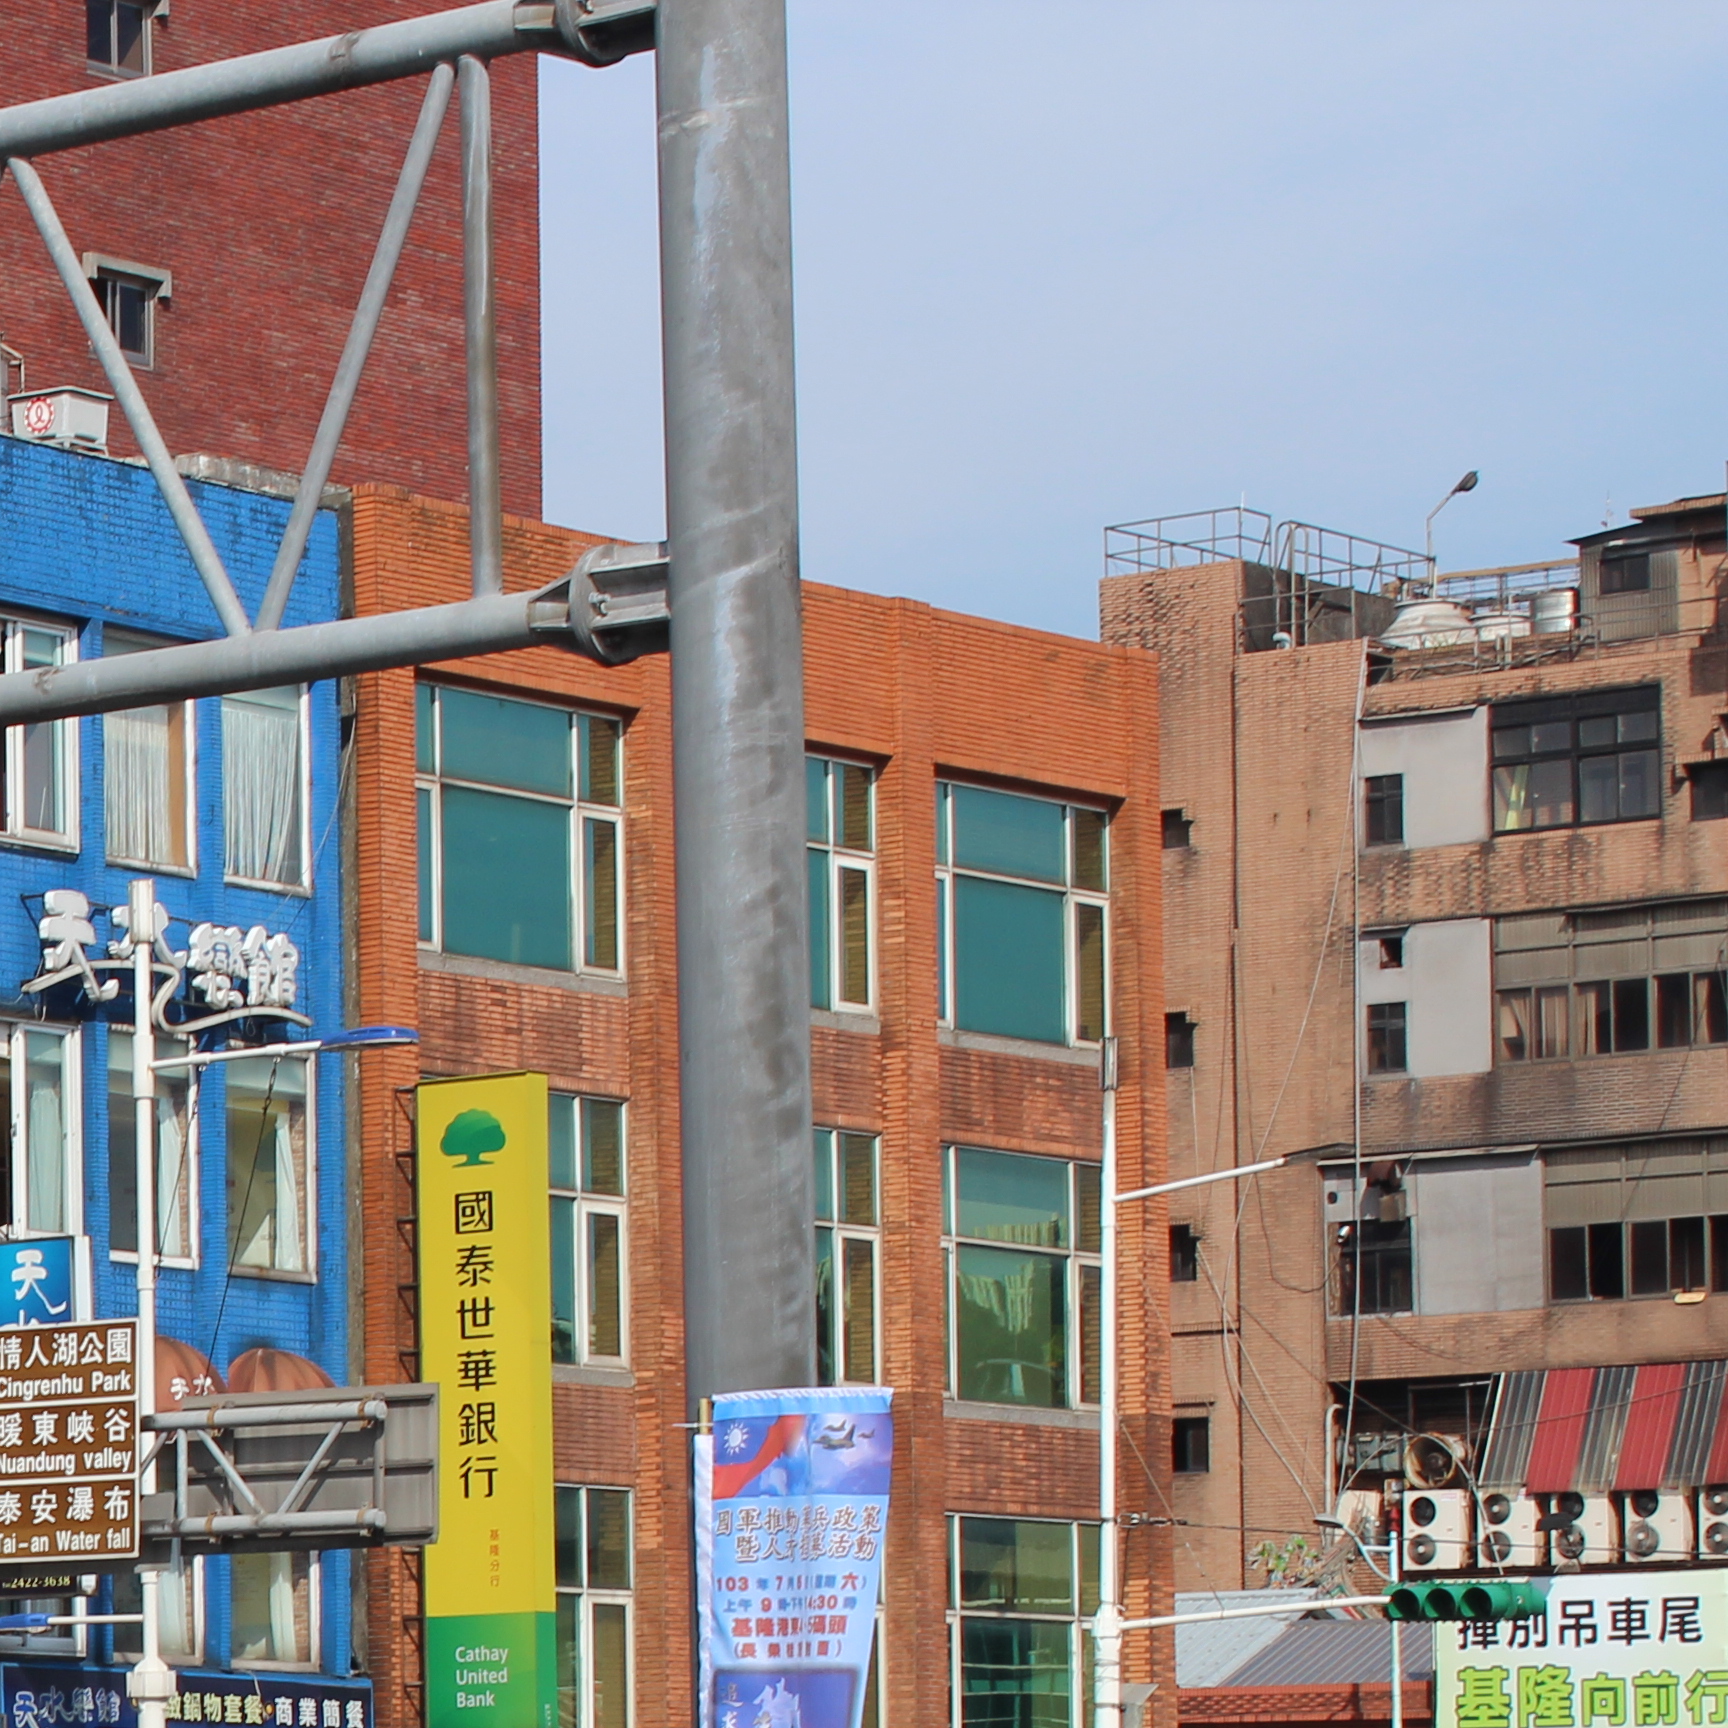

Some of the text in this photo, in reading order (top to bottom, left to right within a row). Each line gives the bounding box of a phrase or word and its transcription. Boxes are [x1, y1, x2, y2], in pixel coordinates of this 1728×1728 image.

[8, 1248, 68, 1328] 天
[452, 1188, 500, 1502] 國泰世華銀行
[91, 1371, 132, 1395] Park
[82, 1445, 132, 1474] valley
[55, 1530, 102, 1553] Water
[106, 1528, 131, 1550] fall
[489, 1528, 500, 1588] 基隆分行
[1456, 1597, 1704, 1650] 揮別吊車尾
[455, 1645, 509, 1667] Cathay
[455, 1667, 508, 1686] United
[455, 1689, 495, 1709] Bank
